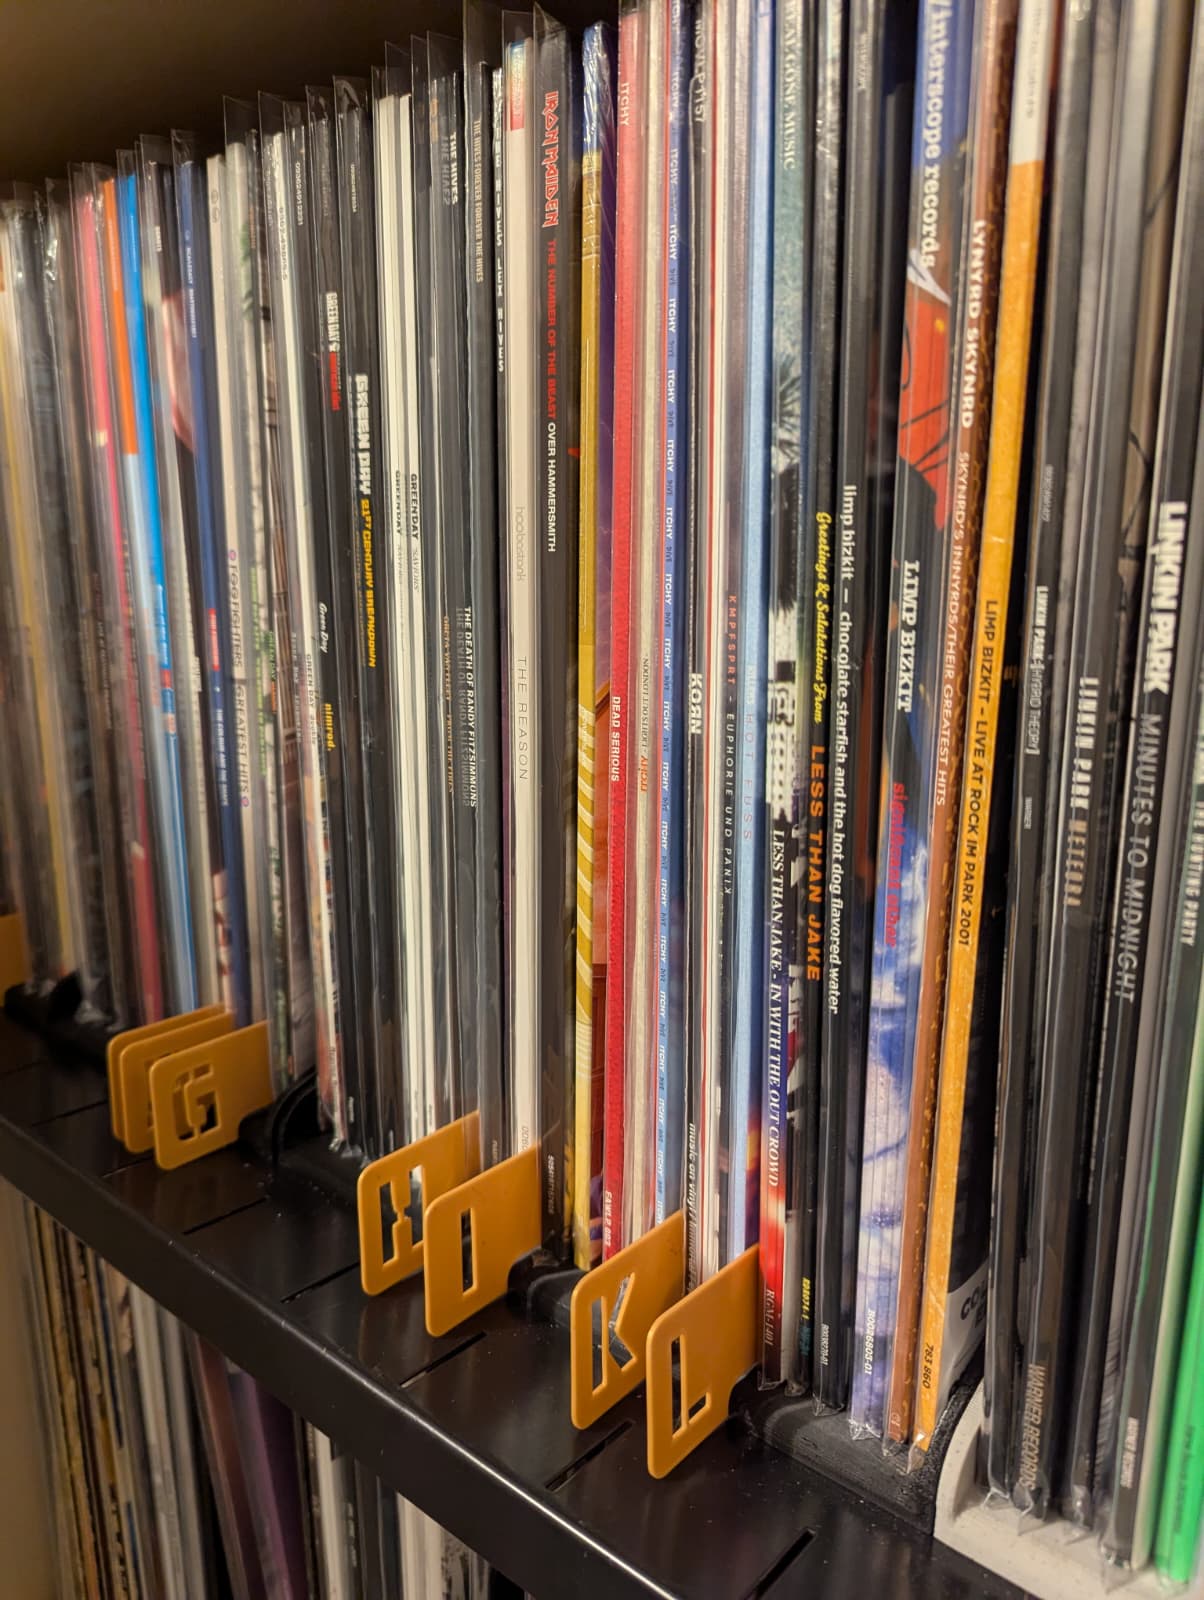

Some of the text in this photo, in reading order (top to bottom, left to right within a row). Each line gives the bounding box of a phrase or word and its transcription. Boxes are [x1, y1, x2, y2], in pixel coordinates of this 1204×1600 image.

[620, 83, 629, 126] ITCHY
[783, 54, 797, 109] GONE
[449, 132, 459, 205] THE HIVES
[783, 111, 797, 170] MUSIC
[473, 119, 484, 282] THE HIVES FOREVER FOREVER THE HIVES
[919, 165, 942, 269] records
[669, 224, 678, 260] ITCHY
[967, 219, 987, 318] LYNYRD
[326, 292, 339, 323] GREEN
[327, 323, 340, 342] DAY
[542, 91, 559, 552] IRON MAIDEN THE NUMBER OF THE BEAST OVER HAMMERSMITH
[355, 374, 371, 449] GREEN
[961, 327, 981, 428] SKYNRD
[358, 451, 372, 495] DAY
[953, 451, 971, 540] SKYNRD'S
[362, 530, 374, 588] CENTURY
[230, 602, 243, 668] FIGHTERS
[319, 602, 329, 653] Green Day
[365, 590, 377, 668] BREAKDOWN
[514, 506, 529, 780] hoobastank THE REASON
[727, 595, 738, 686] KMPFSPRT
[813, 511, 833, 724] Greetings & Salutations From
[897, 560, 921, 712] LIMP BIZKIT
[1033, 586, 1049, 627] LINKIN
[305, 654, 313, 687] GREEN
[664, 638, 672, 669] ITCHY
[235, 685, 249, 759] GREATEST
[307, 690, 315, 708] DAY
[324, 704, 336, 752] nimrod.
[464, 606, 478, 808] THE DEATH OF RANDY FITZSIMMONS
[744, 713, 754, 760] HOT
[938, 684, 954, 767] GREATEST
[611, 696, 621, 782] DEAD SERIOUS
[725, 713, 736, 796] EUPHORIE
[828, 484, 857, 1015] limp bizkit chocolate starfish and the hot dog flavored water
[957, 600, 998, 946] LIMP BIZKIT LIVE AT ROCK IM PARK 2001
[1114, 502, 1188, 1003] LINKIN PARK MINUTES TO MIDNIGHT
[239, 763, 250, 794] HITS
[743, 779, 753, 840] FUSS
[936, 770, 948, 806] HITS
[1063, 677, 1100, 906] LINKIN PARK METEORA
[724, 806, 734, 838] UND
[807, 744, 825, 981] LESS THAN JAKE
[885, 782, 908, 948] significant other
[1180, 900, 1199, 946] PARTY
[768, 829, 785, 1187] LESS THAN JAKE IN WITH THE OUT CROWD
[171, 1063, 222, 1143] G
[688, 1123, 698, 1161] music
[688, 1163, 696, 1180] on
[379, 1163, 426, 1268] H
[686, 1182, 698, 1213] vinyl
[590, 1272, 638, 1396] K
[922, 1342, 935, 1389] 783 860
[670, 1334, 712, 1440] L
[1019, 1364, 1046, 1490] WARNER RECORDS
